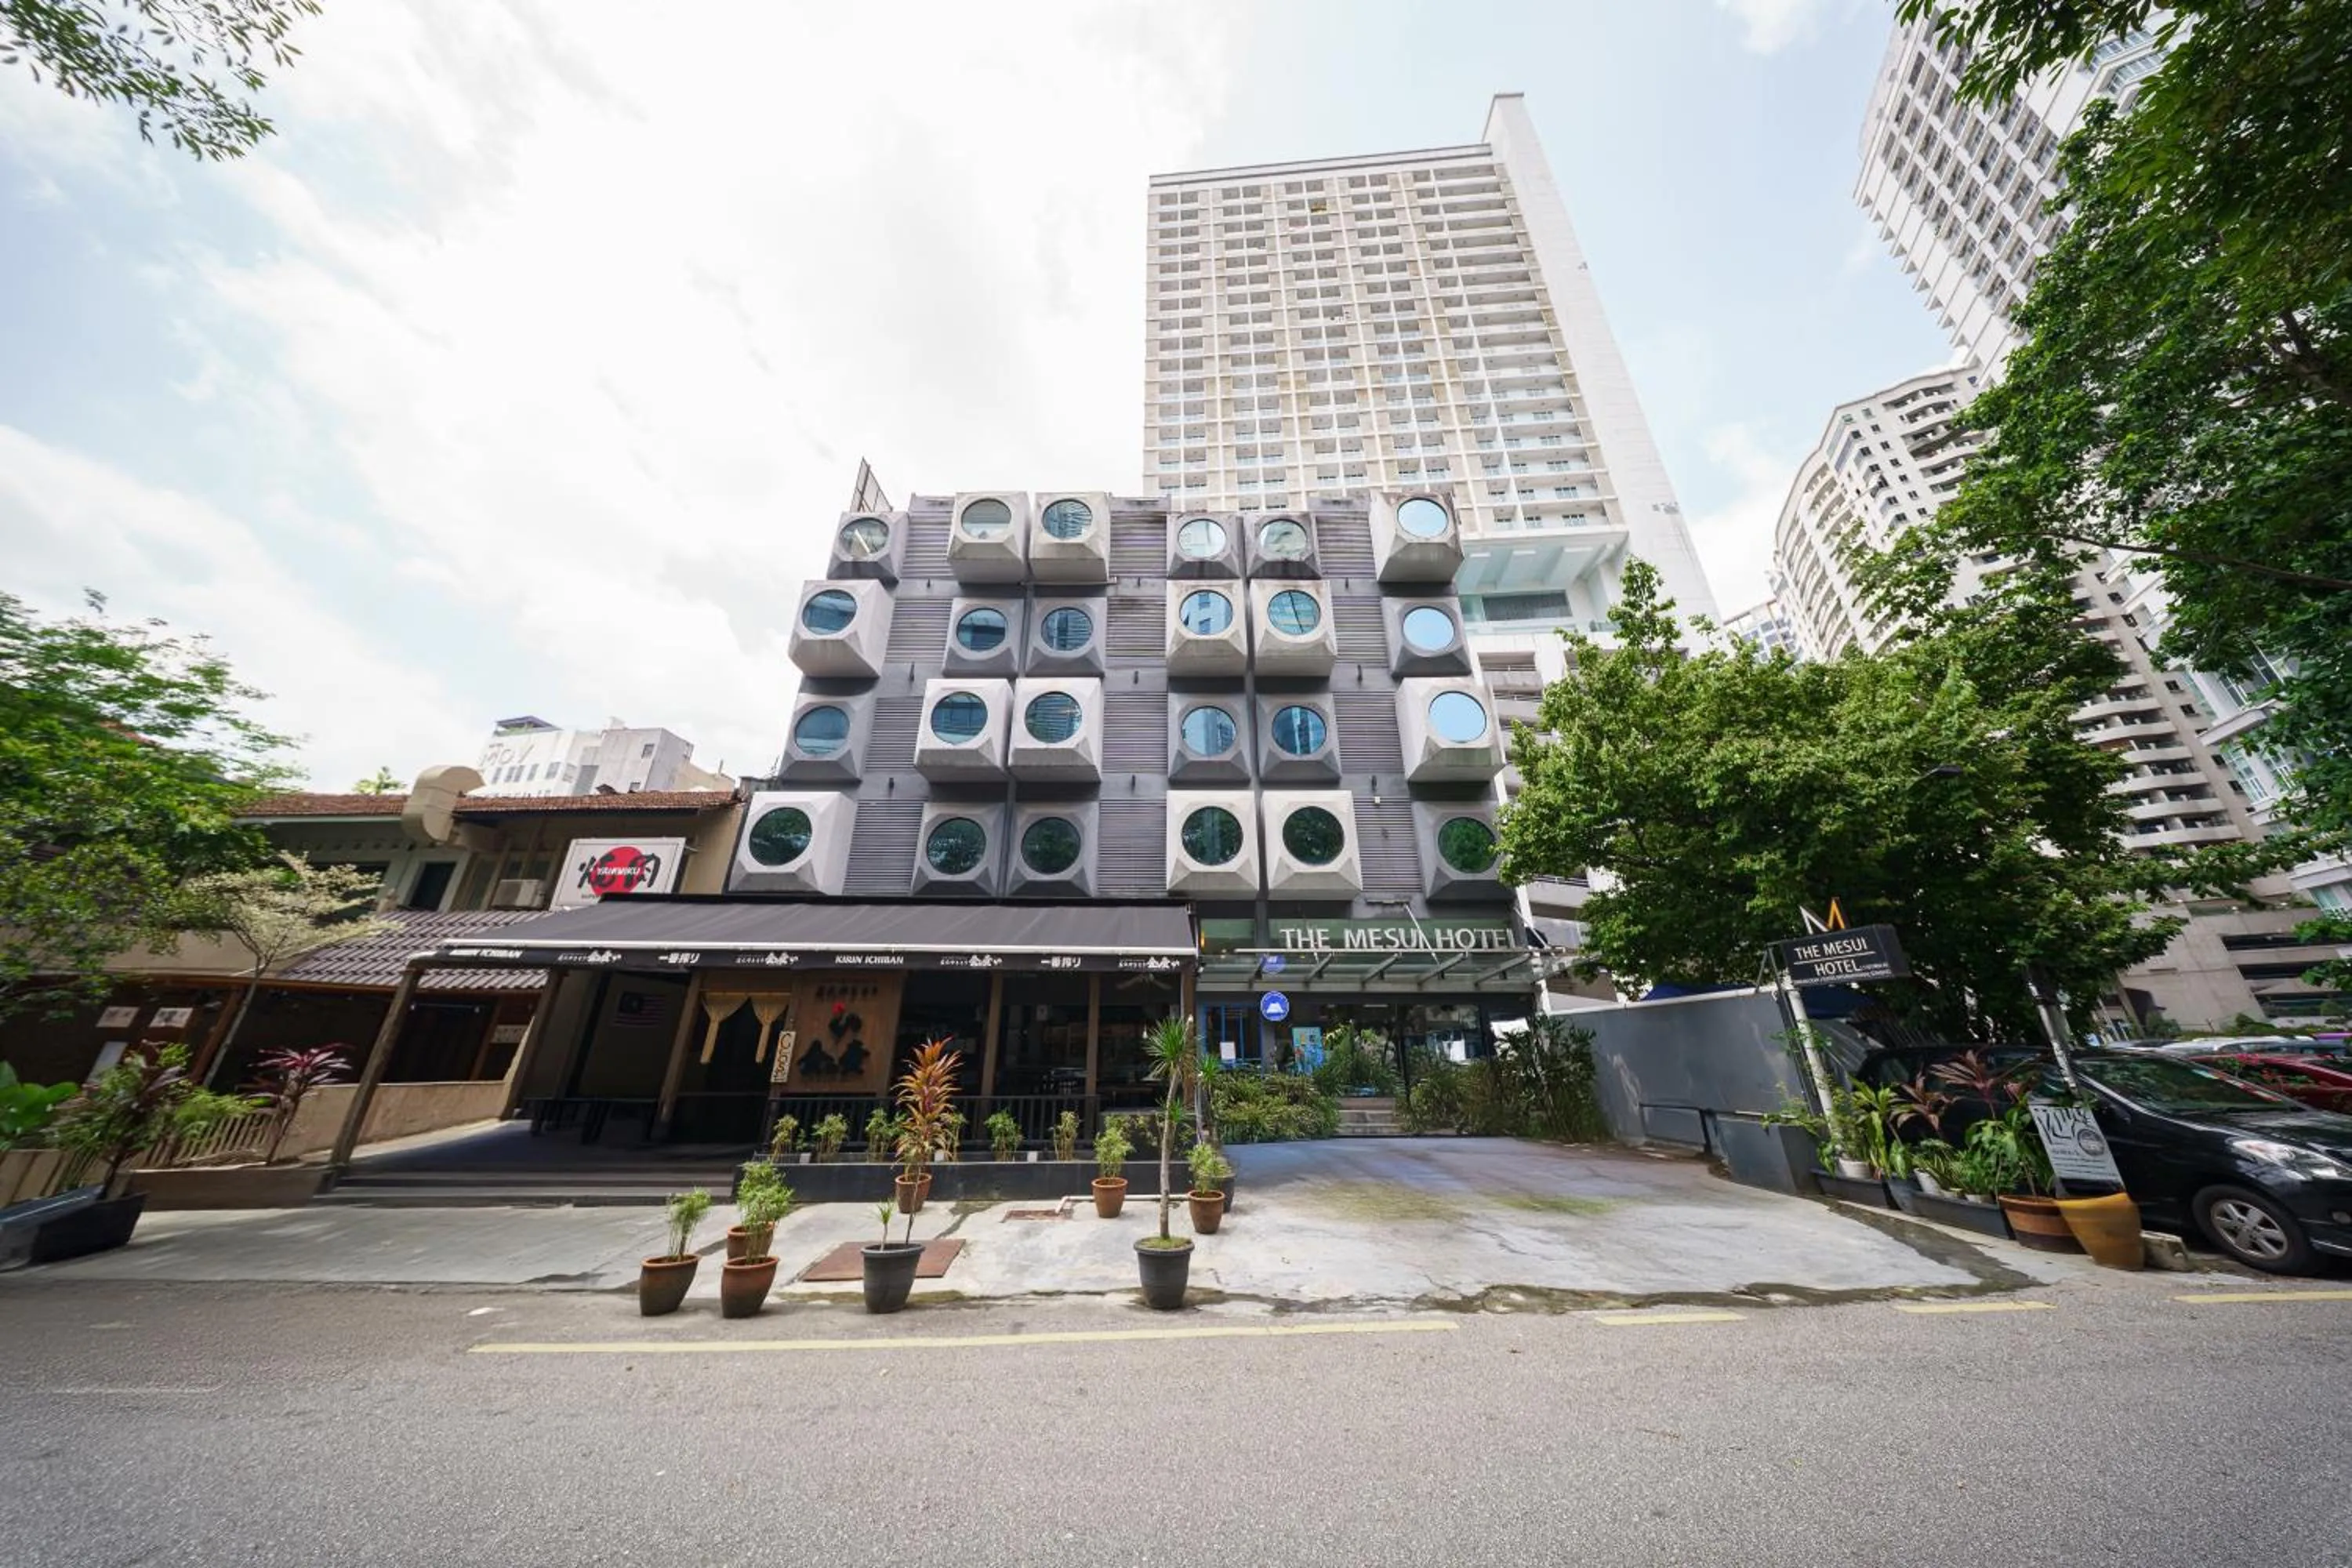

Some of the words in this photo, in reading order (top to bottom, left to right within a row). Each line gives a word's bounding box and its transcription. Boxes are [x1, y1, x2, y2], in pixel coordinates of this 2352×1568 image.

[1279, 927, 1330, 949] THE
[1433, 927, 1518, 949] HOTEL
[1794, 944, 1821, 960] THE
[1823, 937, 1868, 956] MESUI
[835, 954, 863, 964] KIRIN
[865, 954, 904, 965] ICHIBAN
[1814, 959, 1861, 976] HOTEL
